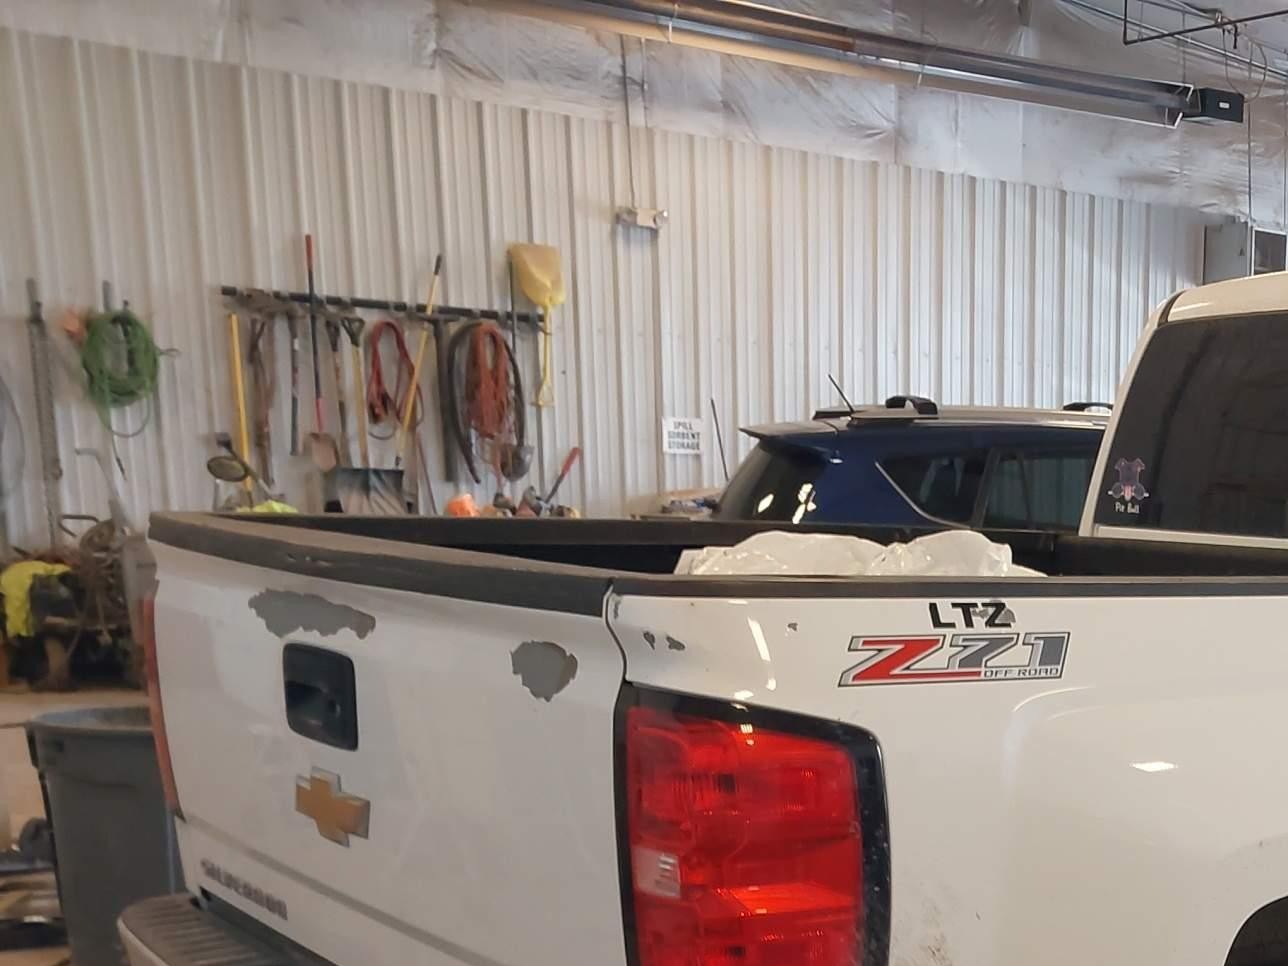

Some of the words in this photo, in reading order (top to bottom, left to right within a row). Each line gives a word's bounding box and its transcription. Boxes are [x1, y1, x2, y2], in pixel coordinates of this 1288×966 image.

[928, 602, 1013, 629] LTZ
[838, 631, 1070, 687] Z71
[984, 669, 1014, 678] OFF
[1017, 667, 1059, 677] ROAD
